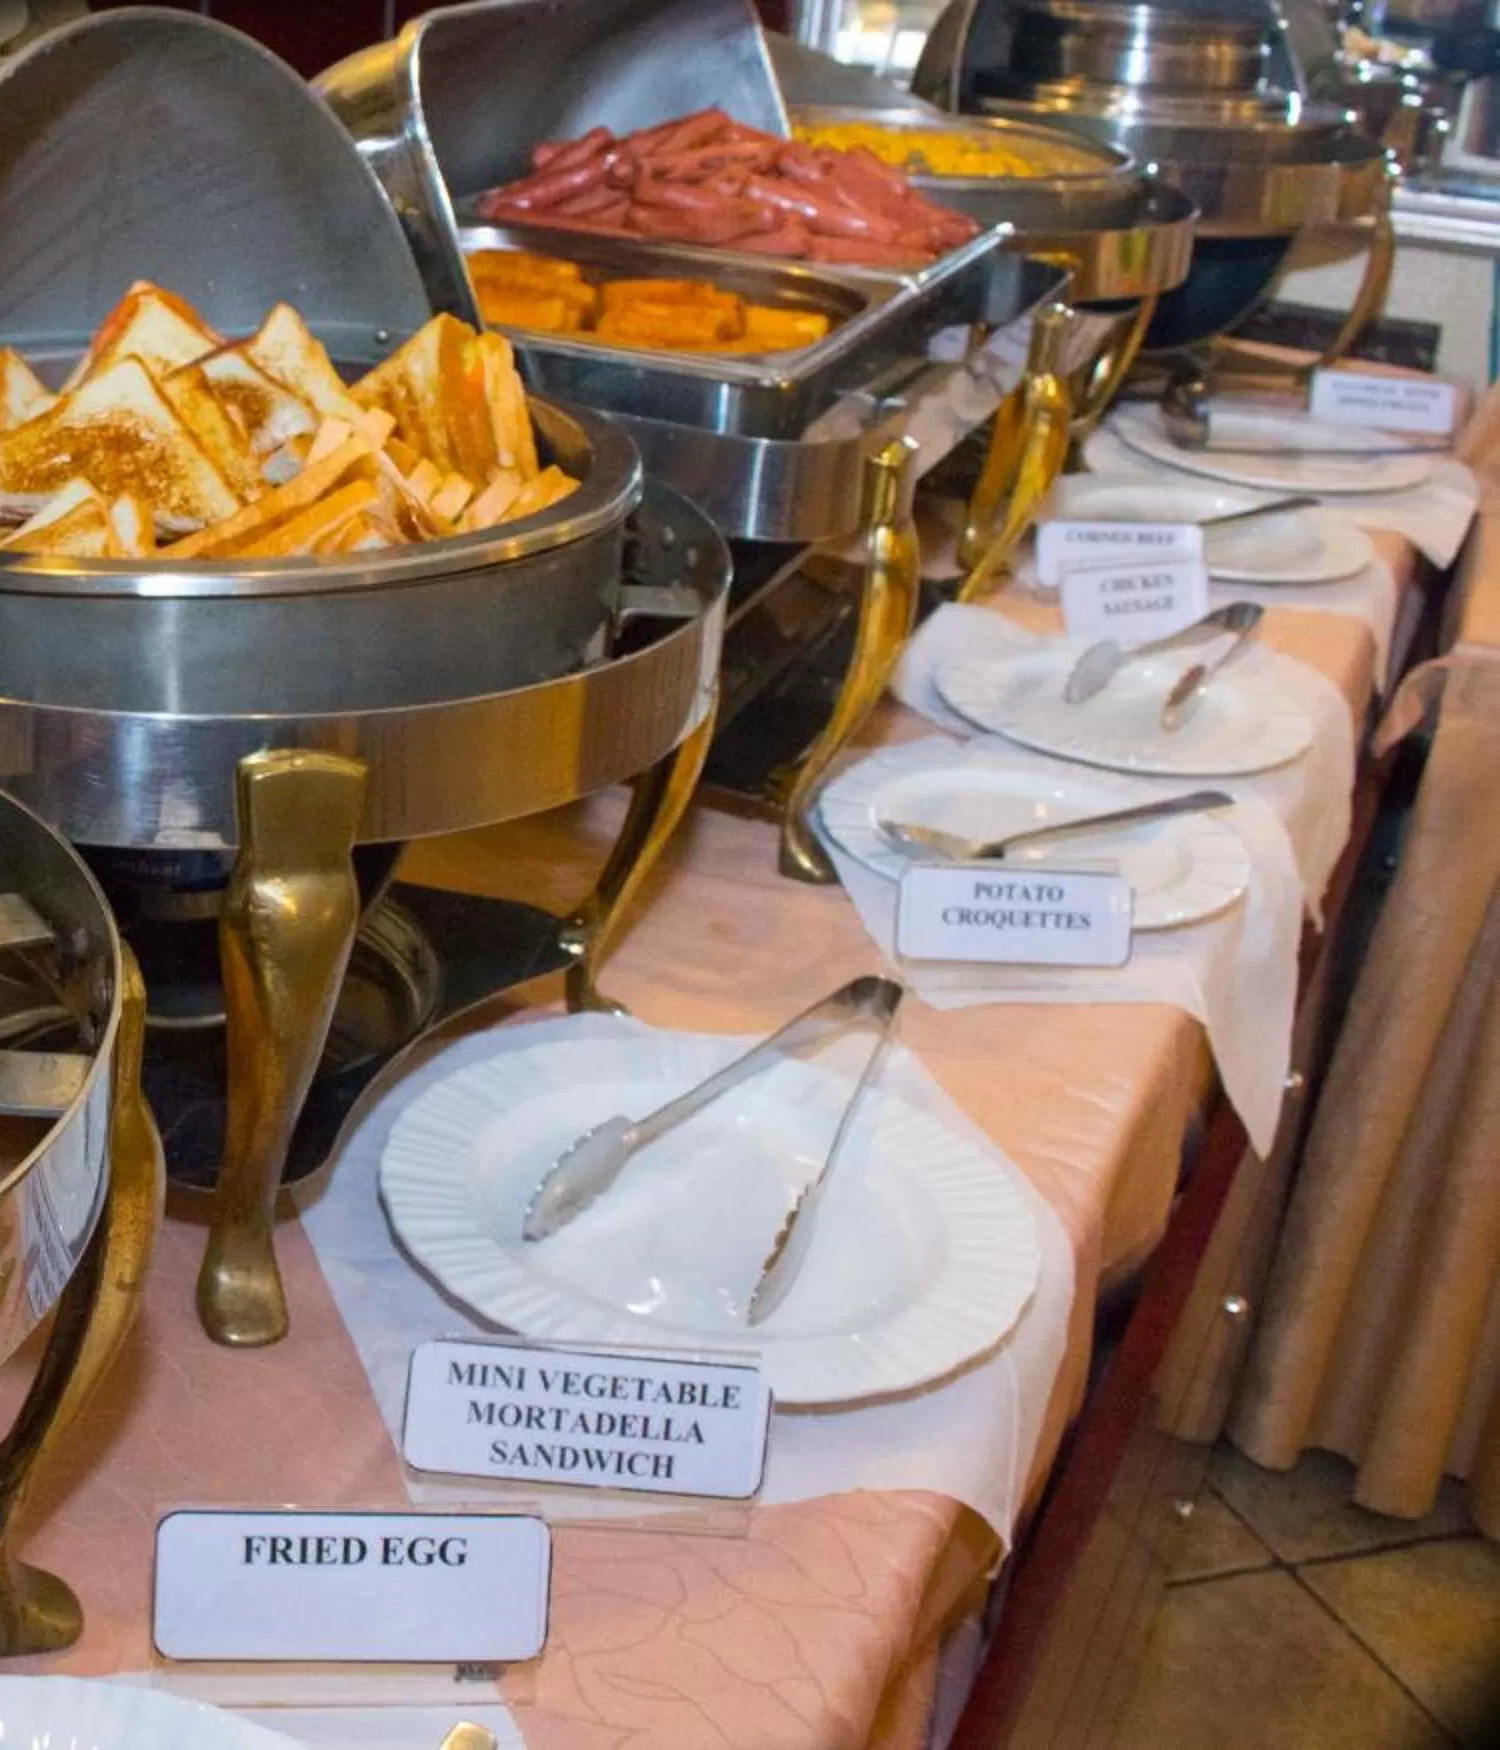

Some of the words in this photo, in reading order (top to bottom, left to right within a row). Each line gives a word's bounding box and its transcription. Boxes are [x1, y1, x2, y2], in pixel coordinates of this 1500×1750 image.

[1100, 573, 1174, 592] CHICKEN
[973, 881, 1065, 903] POTATO
[941, 907, 1092, 929] CROQUETTES
[447, 1361, 526, 1392] MINI
[538, 1368, 741, 1410] VEGETABLE
[466, 1400, 706, 1445] MORTADELLA
[488, 1440, 676, 1479] SANDWICH
[242, 1535, 367, 1565] FRIED
[380, 1537, 468, 1567] EGG
